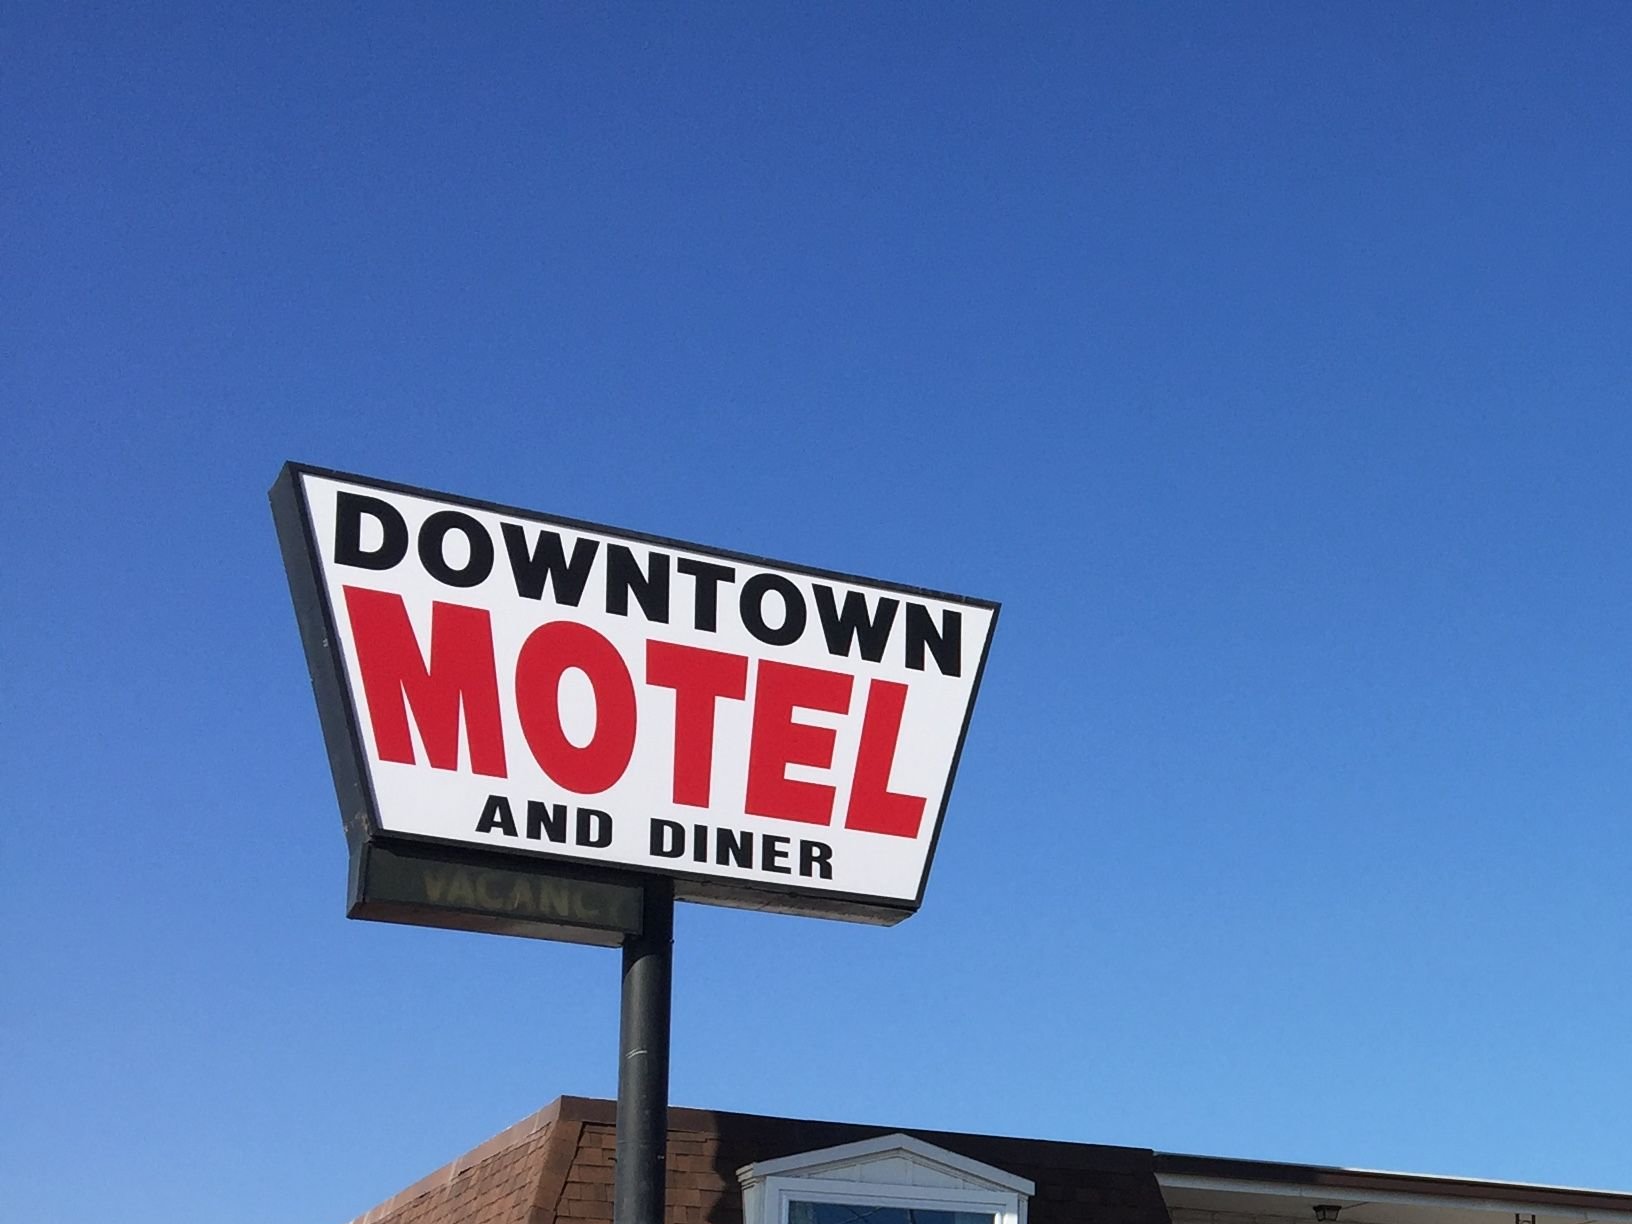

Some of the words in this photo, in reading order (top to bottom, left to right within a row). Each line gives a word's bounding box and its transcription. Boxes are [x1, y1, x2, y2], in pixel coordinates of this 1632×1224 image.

[334, 490, 963, 678] DOWNTOWN
[342, 584, 927, 839] MOTEL
[475, 794, 614, 849] AND
[649, 818, 834, 880] DINER
